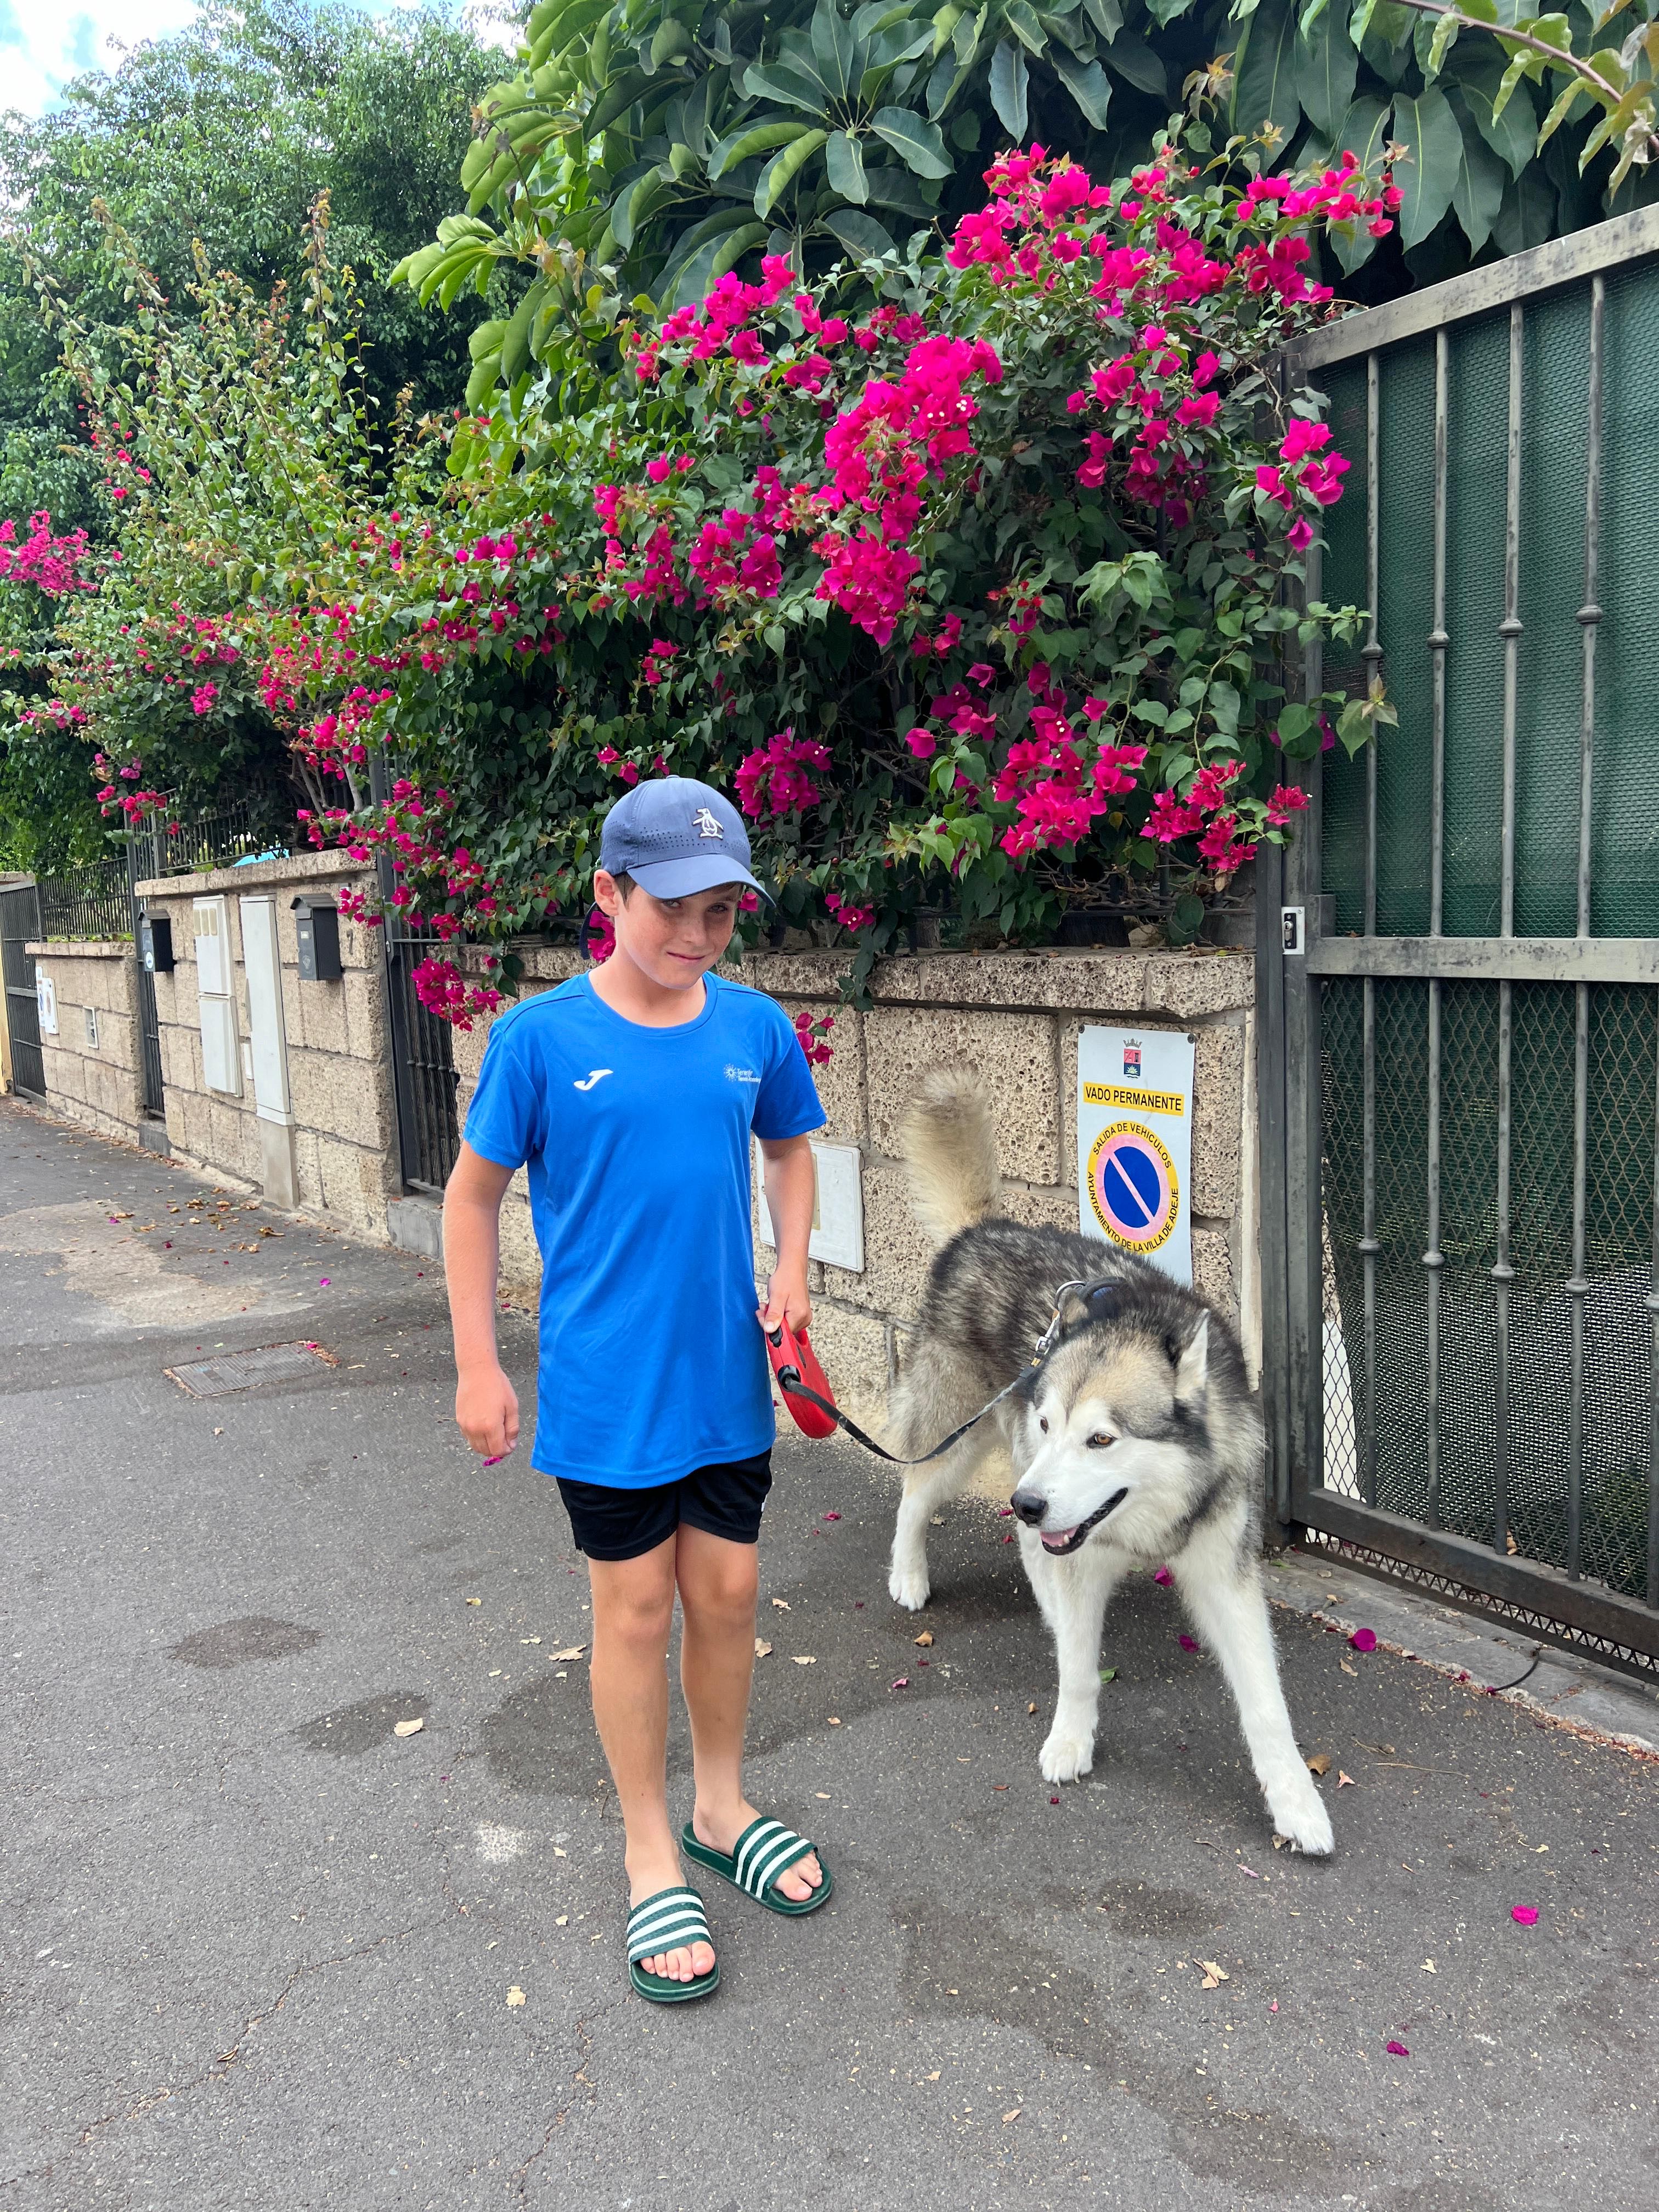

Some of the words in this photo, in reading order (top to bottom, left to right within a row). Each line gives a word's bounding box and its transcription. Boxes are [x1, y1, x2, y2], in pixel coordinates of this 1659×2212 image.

[1086, 1086, 1111, 1101] VADO
[1113, 1090, 1182, 1111] PERMANENTE
[1093, 1126, 1116, 1155] SALIDA
[1117, 1122, 1128, 1132] DE
[1130, 1123, 1172, 1169] VEHICULOS
[1088, 1171, 1120, 1243] AYUNTAMIENTO
[1121, 1238, 1132, 1250] DE
[1133, 1243, 1144, 1252] LA
[1143, 1234, 1165, 1250] VILLA
[1161, 1221, 1173, 1238] DE
[1169, 1188, 1178, 1224] ADEJE
